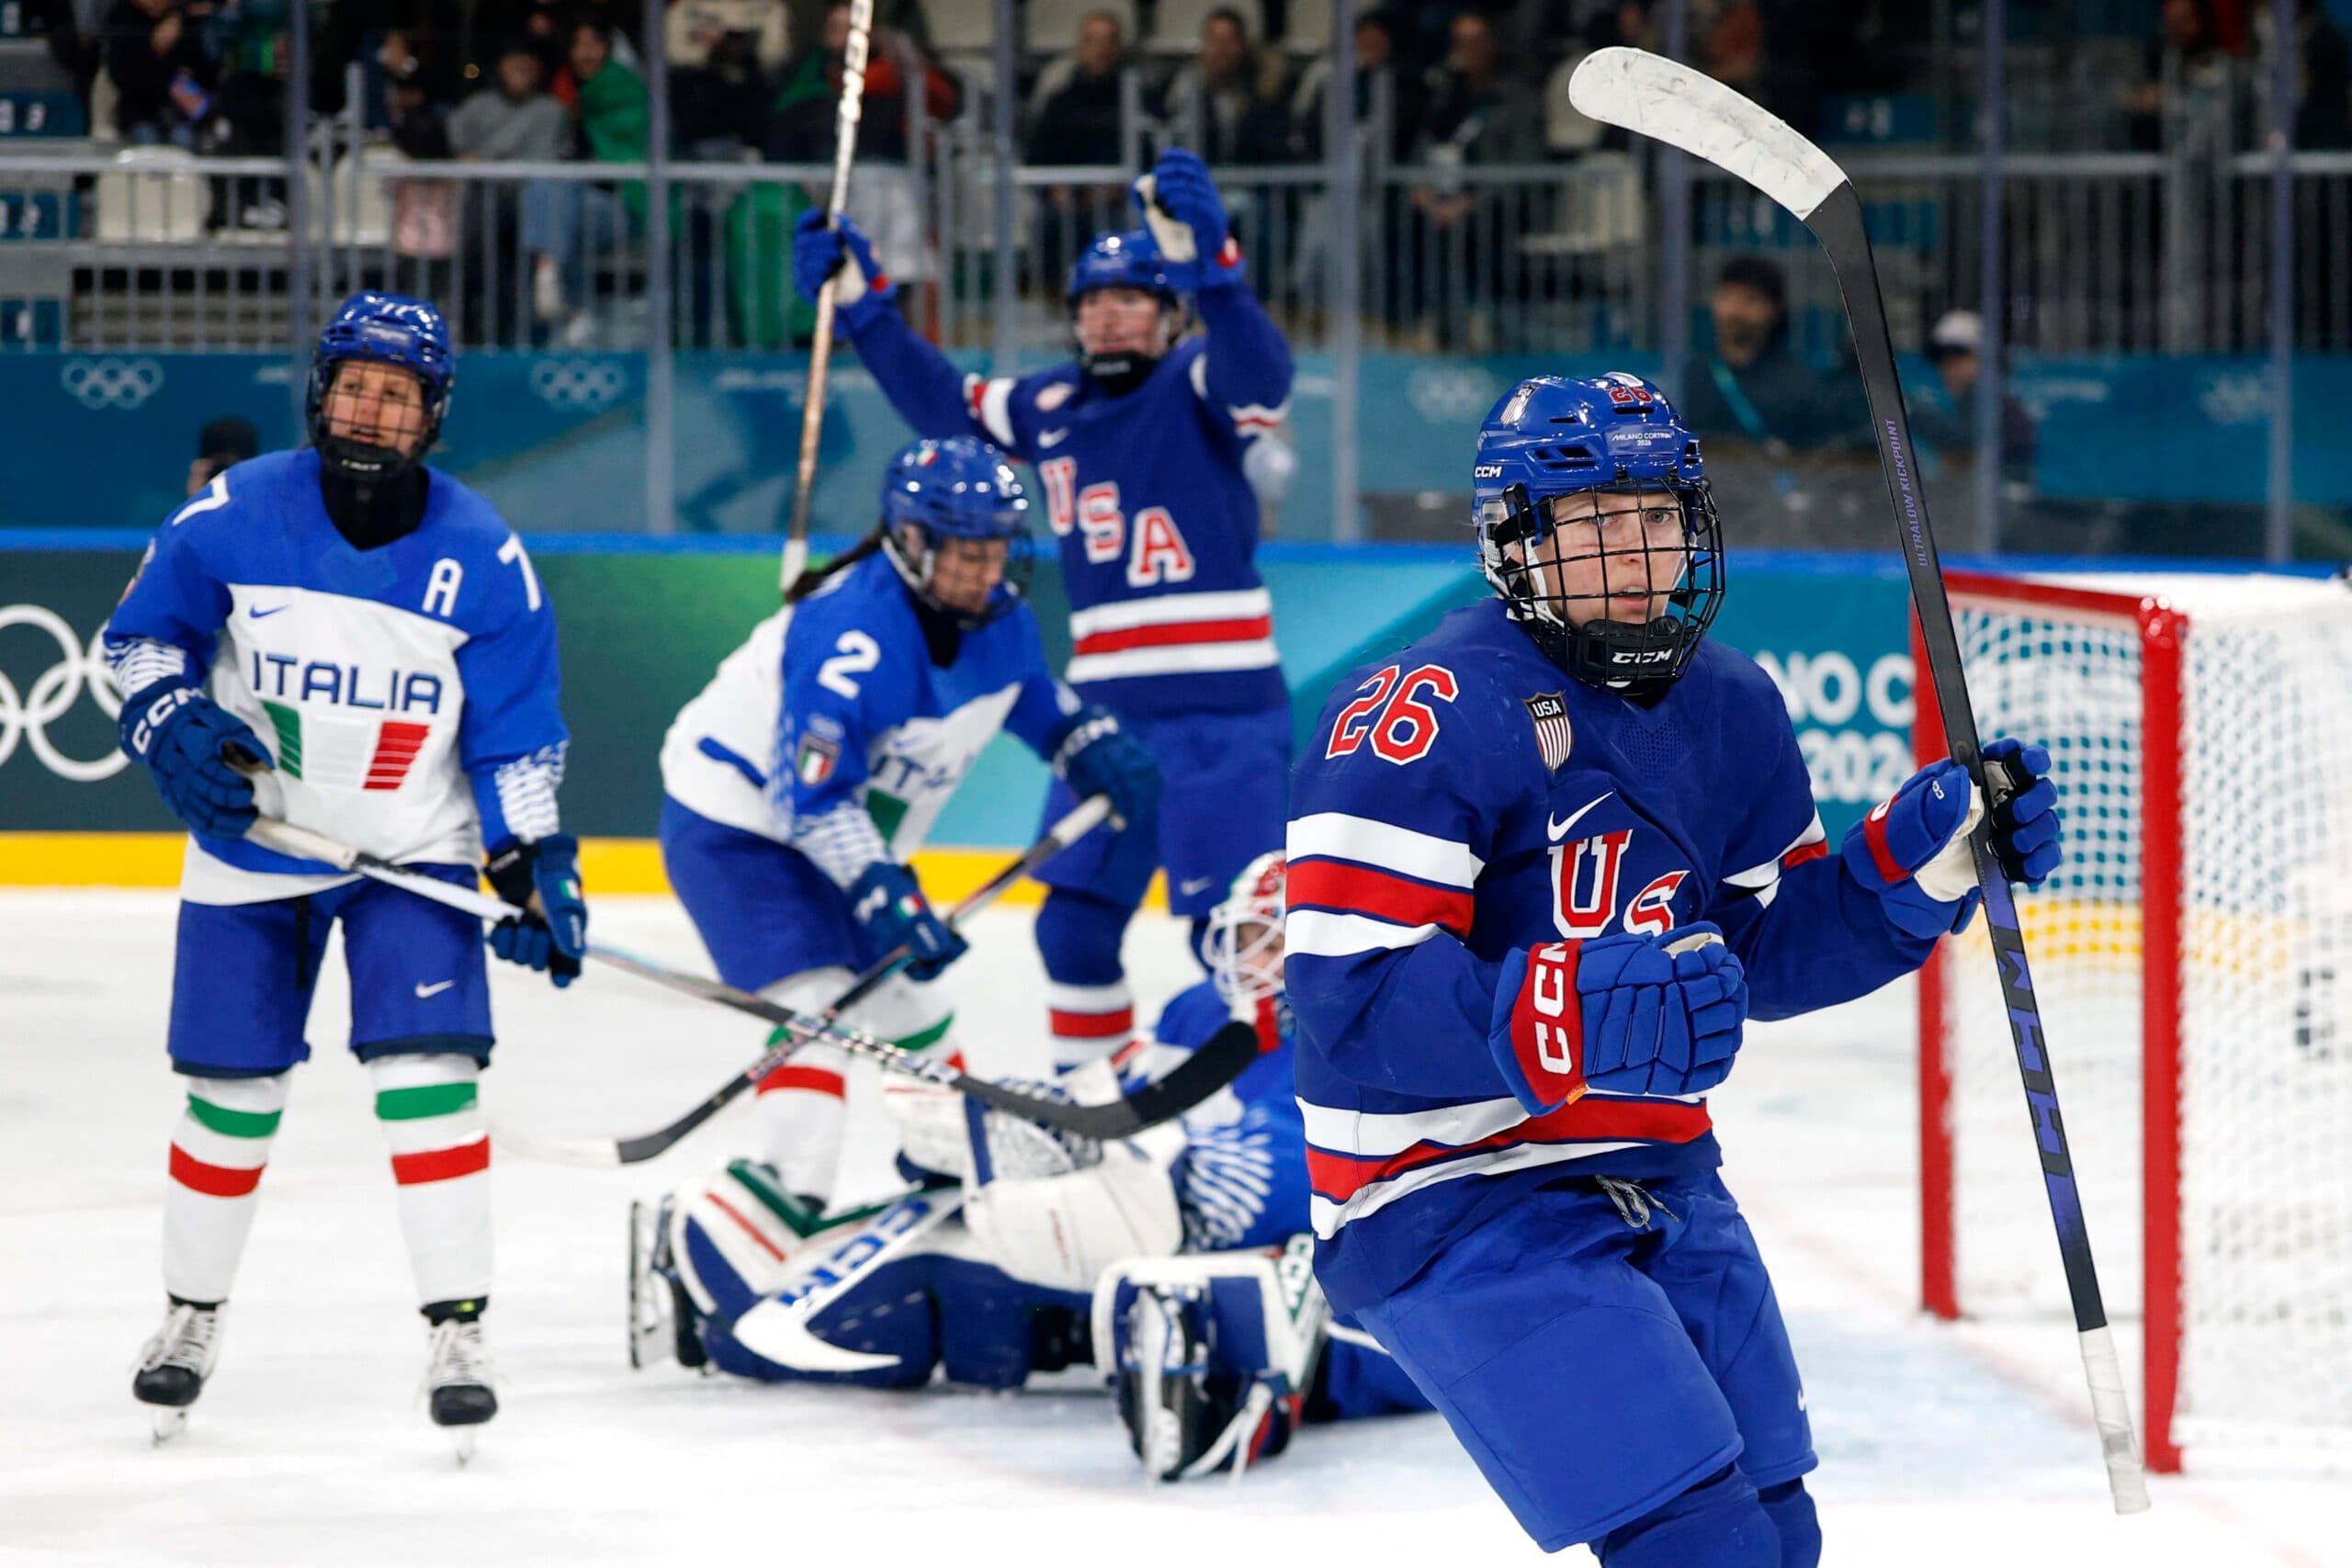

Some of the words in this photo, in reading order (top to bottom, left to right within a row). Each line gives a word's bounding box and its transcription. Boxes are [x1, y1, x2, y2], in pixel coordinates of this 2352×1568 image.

[1603, 386, 1653, 404] 26
[1474, 466, 1503, 479] CCM
[1611, 433, 1643, 442] MILANO
[1885, 419, 1911, 491] KICKPOINT
[172, 470, 230, 526] 7
[1038, 456, 1195, 588] USA
[1903, 493, 1928, 567] ULTRALOW
[422, 557, 464, 617] A
[497, 532, 542, 613] 7
[253, 650, 443, 715] ITALIA
[817, 629, 881, 700] 2
[1611, 648, 1673, 664] CCM
[1325, 663, 1459, 766] 26
[1532, 699, 1562, 717] USA
[1798, 728, 1917, 806] 202
[1547, 829, 1690, 939] US
[1992, 925, 2071, 1178] CCM
